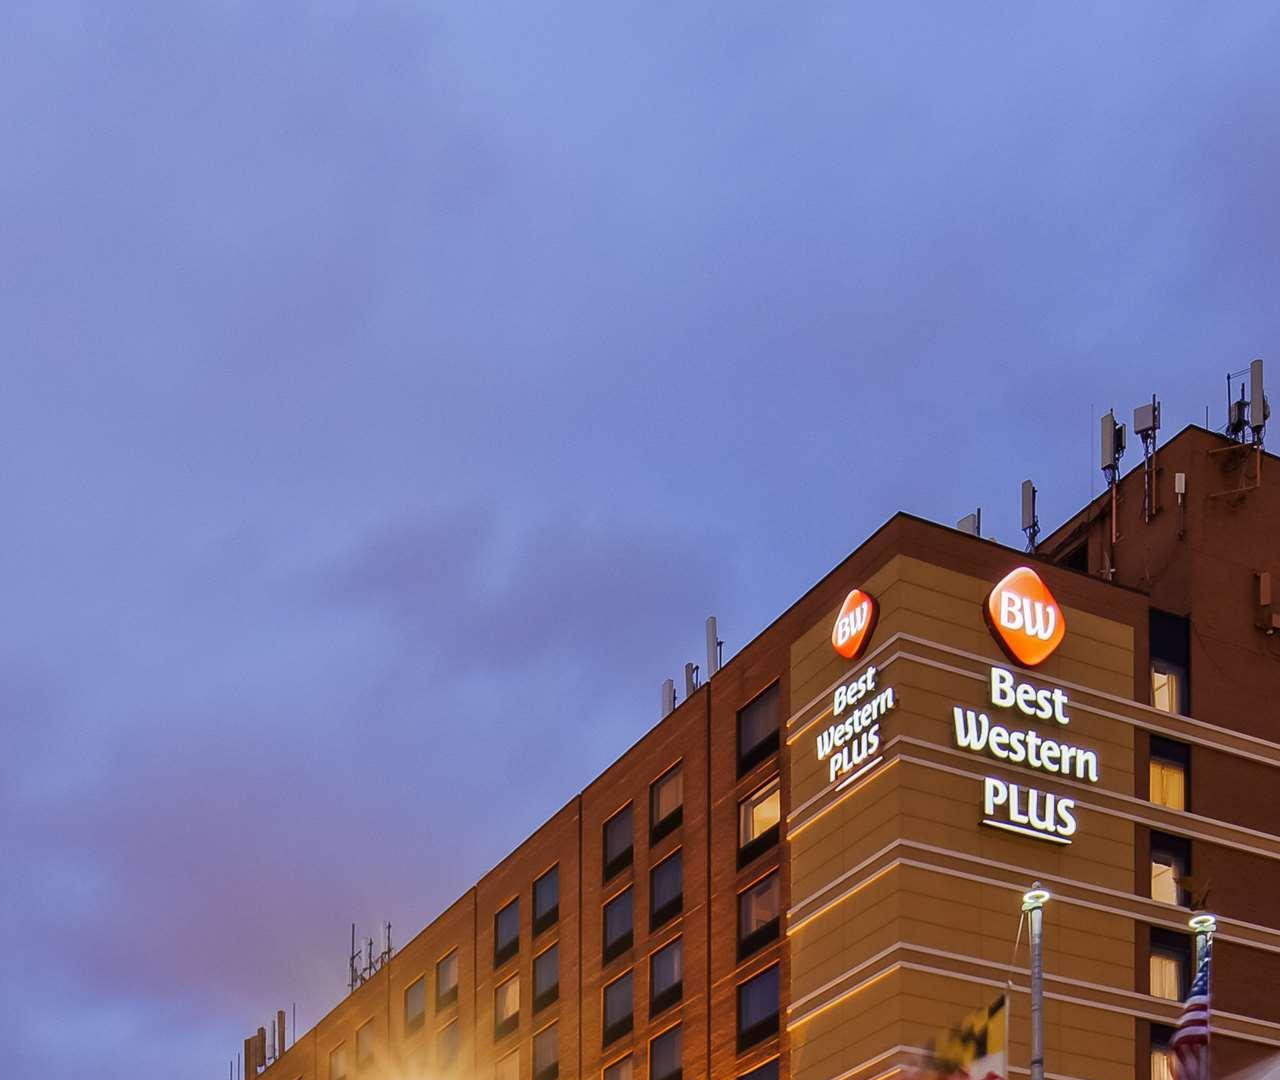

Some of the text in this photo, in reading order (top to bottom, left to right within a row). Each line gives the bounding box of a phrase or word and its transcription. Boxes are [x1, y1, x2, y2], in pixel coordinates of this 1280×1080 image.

[837, 601, 869, 648] BW
[1000, 590, 1056, 641] BW
[833, 667, 876, 716] Best
[991, 667, 1070, 725] Best
[817, 687, 894, 761] Western
[953, 706, 1099, 782] Western
[830, 724, 880, 783] PLUS
[984, 776, 1077, 837] PLUS
